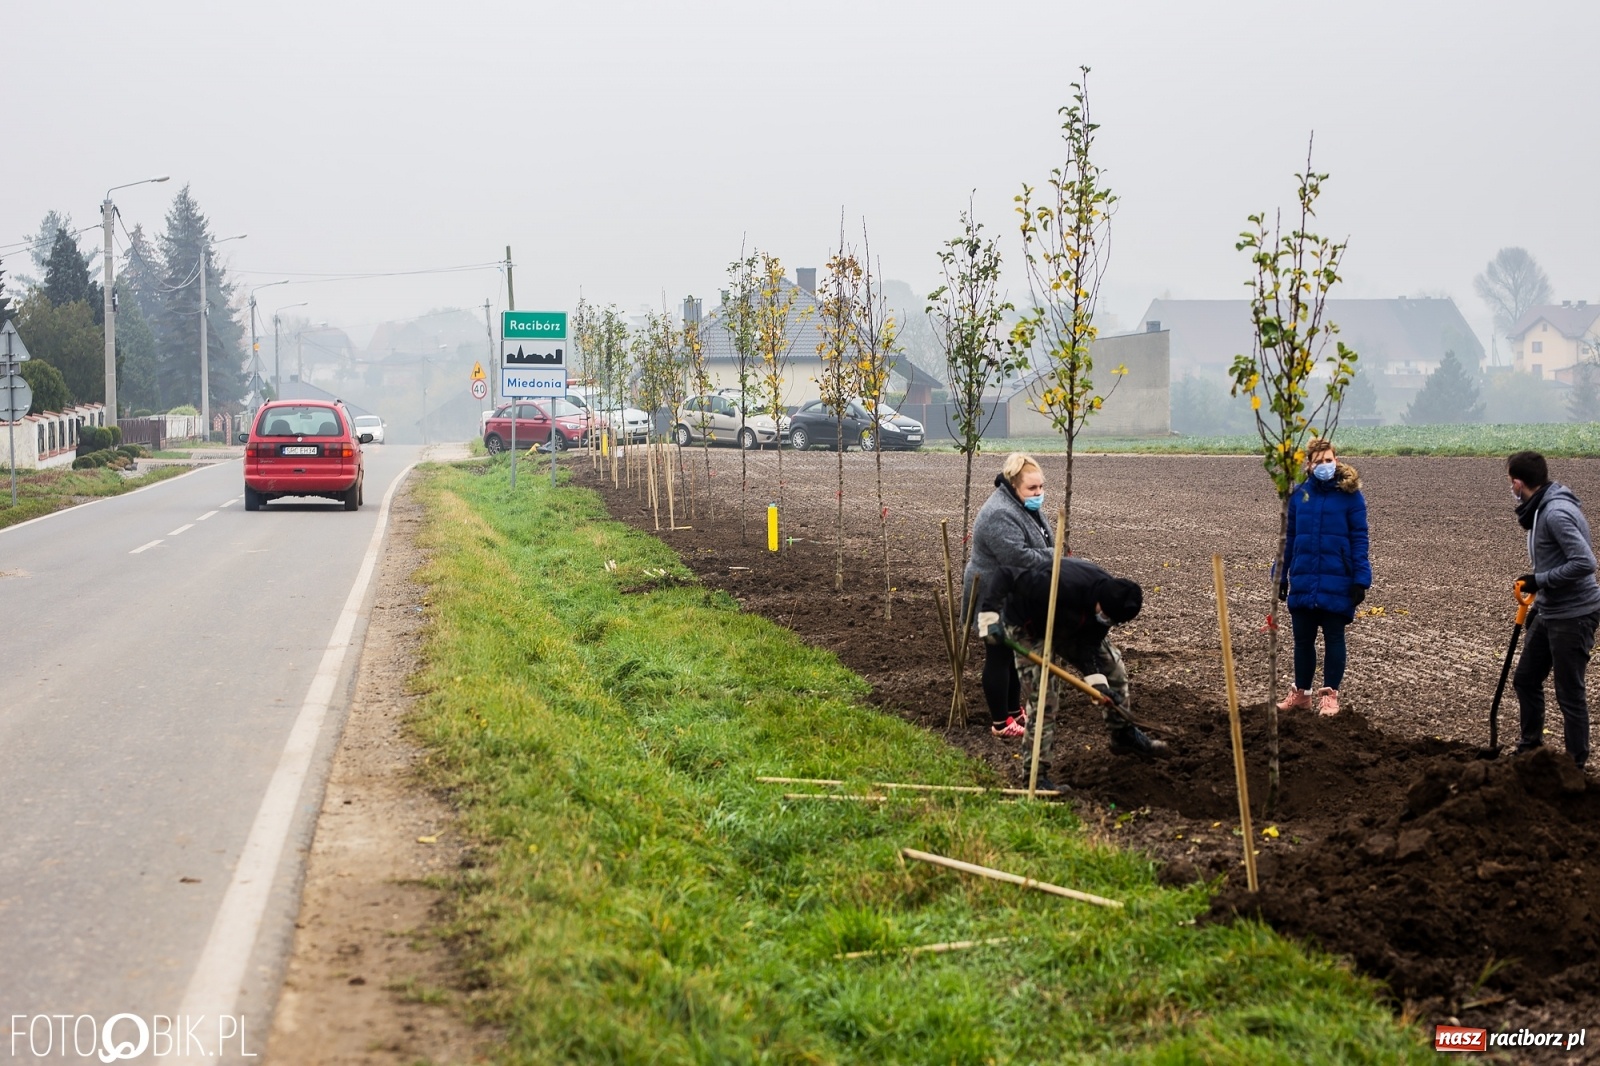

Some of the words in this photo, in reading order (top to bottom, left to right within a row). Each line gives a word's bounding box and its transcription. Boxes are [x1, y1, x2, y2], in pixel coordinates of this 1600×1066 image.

[510, 320, 561, 331] Racibórz
[507, 378, 562, 388] Miedonia
[473, 384, 485, 394] 40
